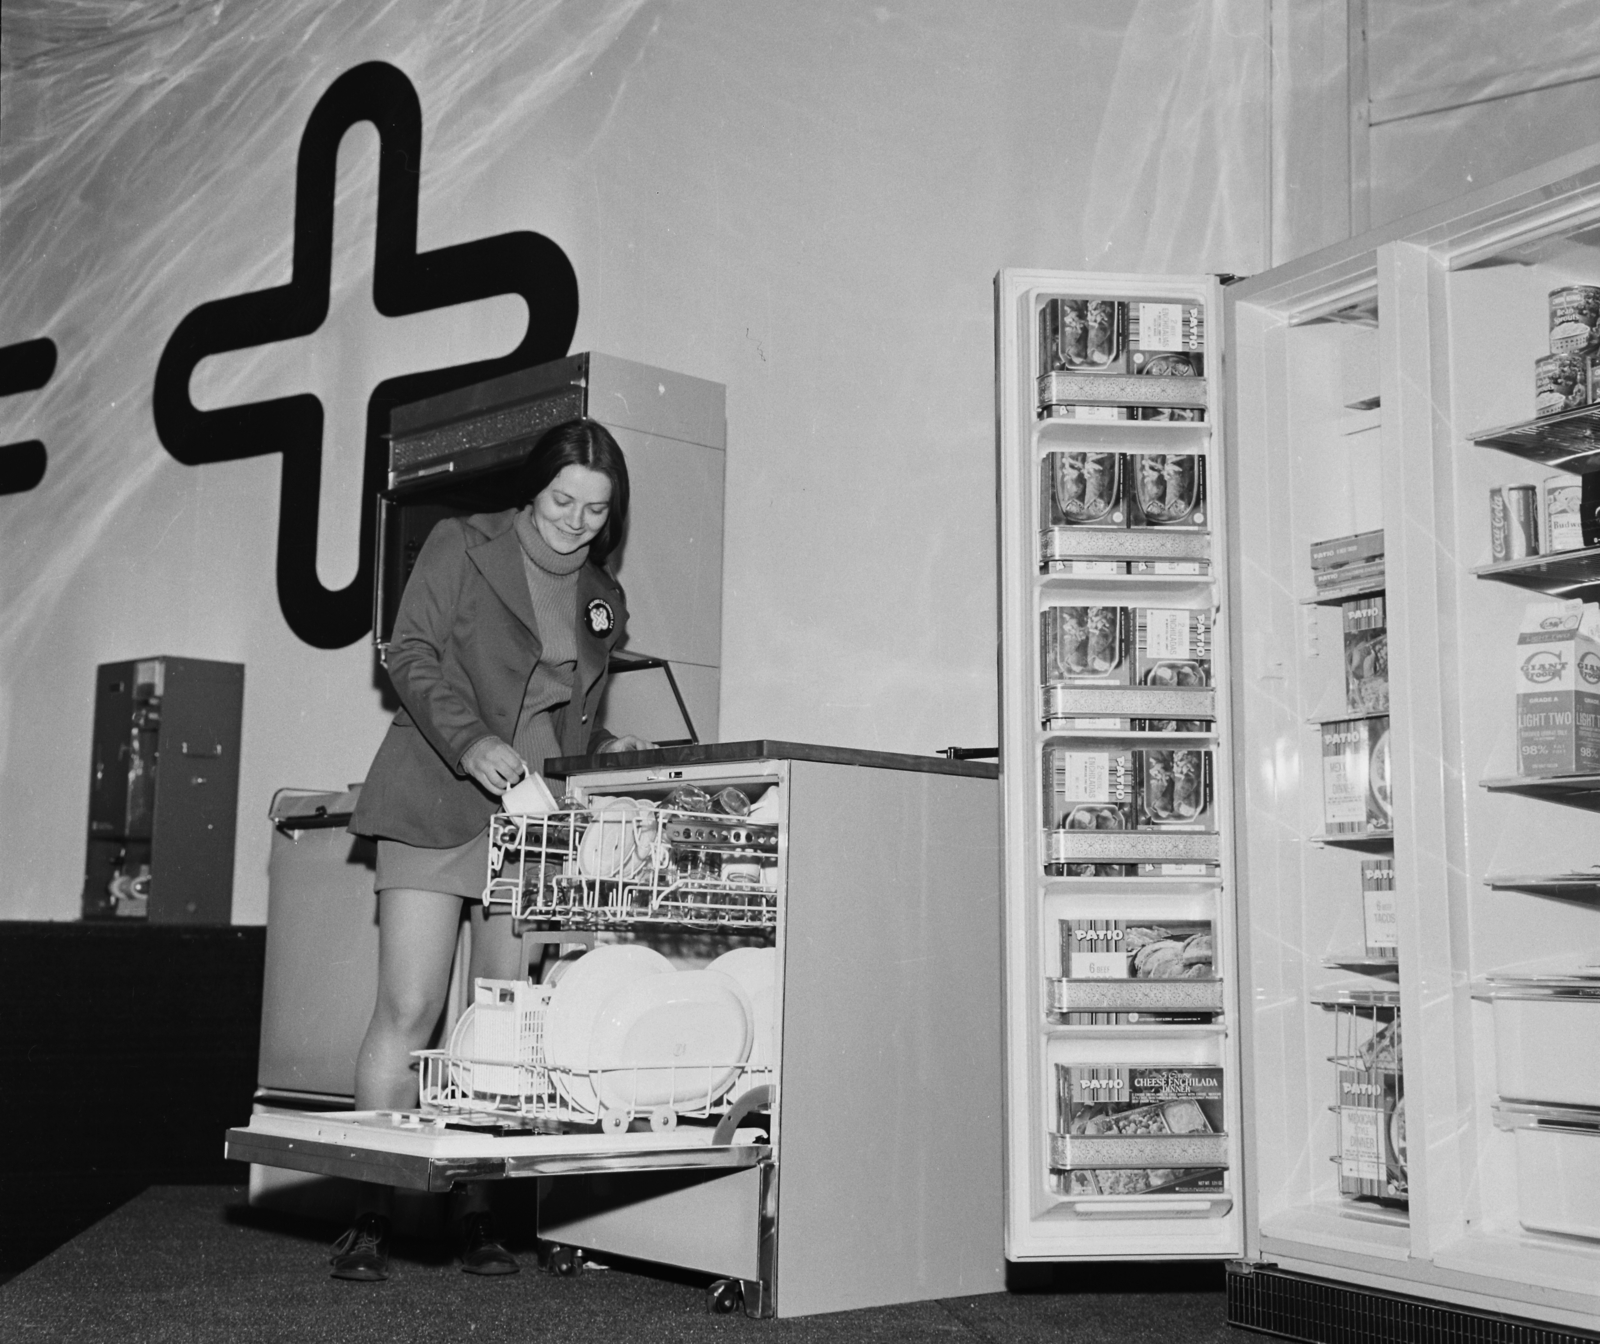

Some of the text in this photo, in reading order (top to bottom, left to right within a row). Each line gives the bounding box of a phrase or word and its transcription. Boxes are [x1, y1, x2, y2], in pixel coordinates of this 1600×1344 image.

[1189, 307, 1198, 349] PATIO
[1313, 550, 1335, 559] PATIO
[1318, 573, 1338, 582] PATIO
[1347, 607, 1379, 620] PATIO
[1169, 614, 1177, 655] ENCHILADAS
[1197, 613, 1205, 657] PATIO
[1521, 662, 1568, 672] GIANT
[1518, 711, 1572, 728] LIGHT TWO
[1576, 712, 1595, 728] LIGHT
[1324, 731, 1360, 745] PATIO
[1522, 745, 1549, 755] 98%
[1088, 756, 1097, 798] ENCHILADAS
[1116, 756, 1125, 800] PATIO
[1365, 869, 1394, 880] PATI
[1074, 930, 1124, 941] PATIO
[1089, 962, 1095, 973] 6
[1079, 1079, 1124, 1090] PATIO
[1134, 1077, 1218, 1087] CHEESE ENCHILADA
[1162, 1085, 1191, 1093] DINNER
[1342, 1082, 1381, 1096] PATIO
